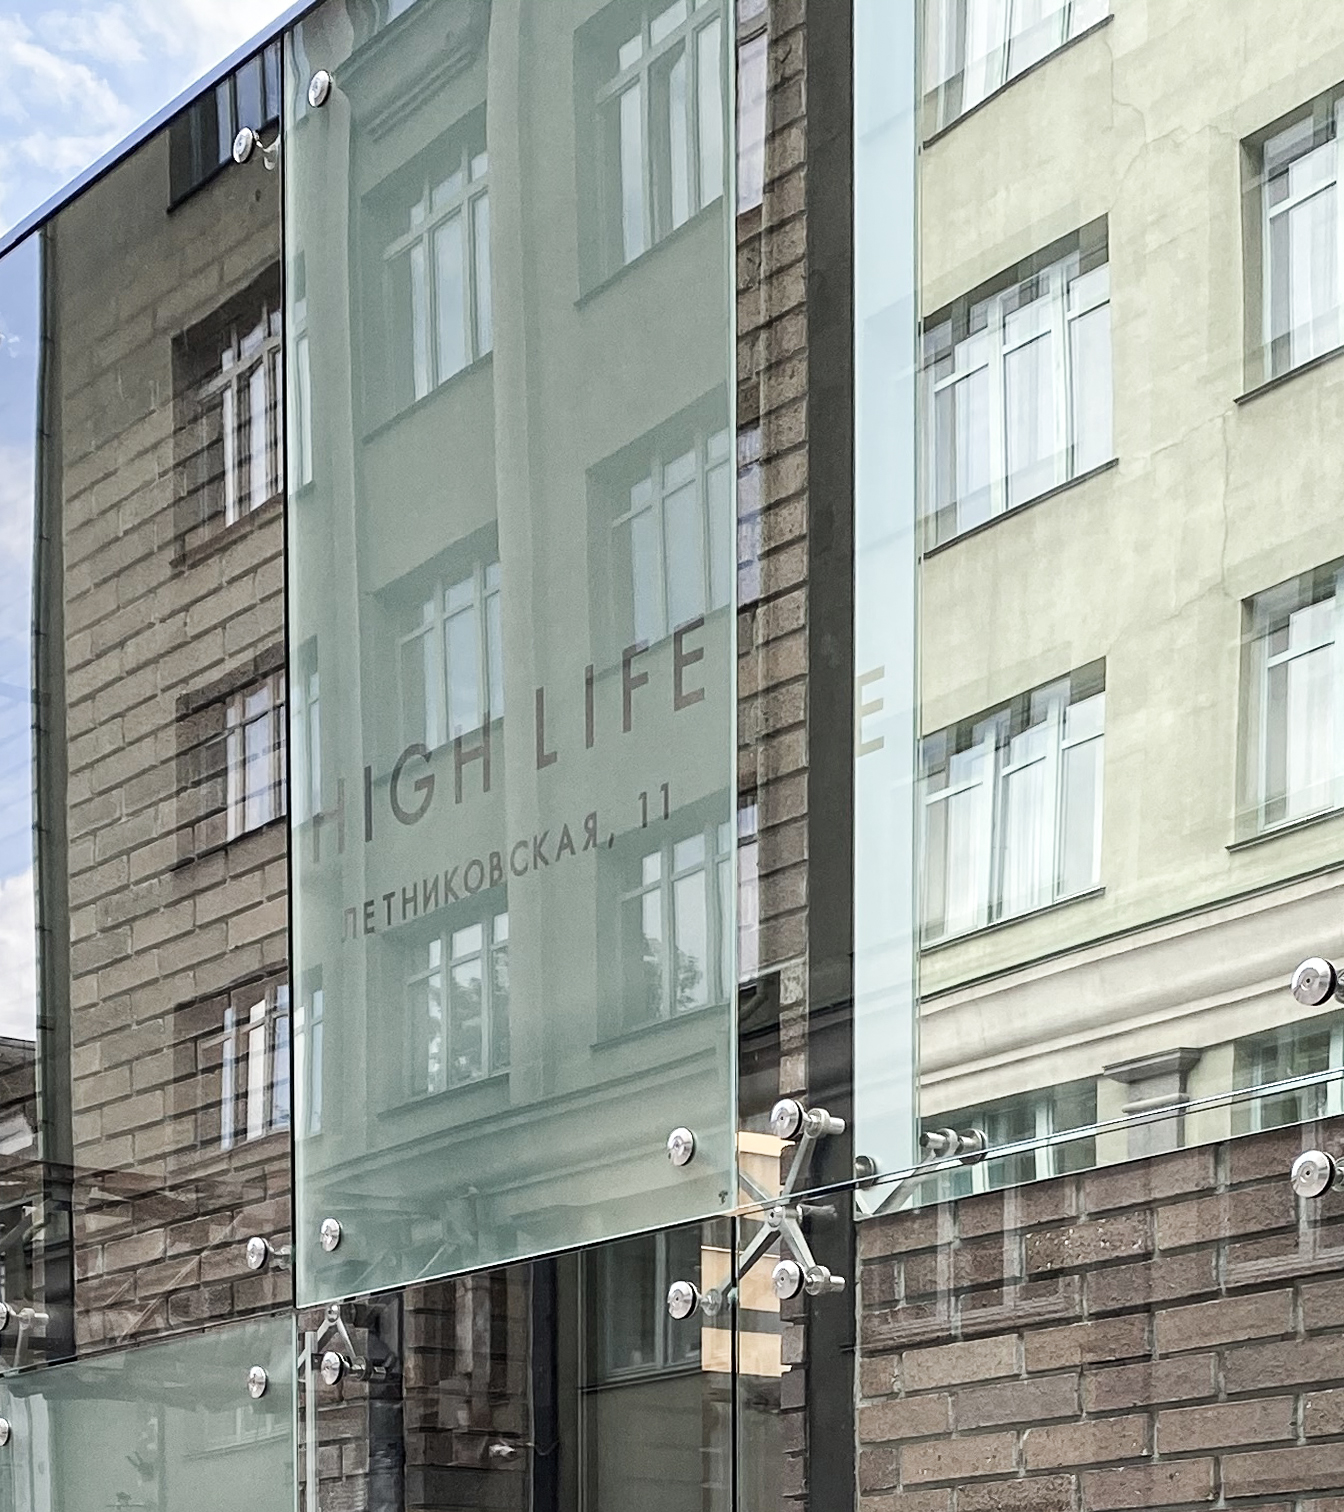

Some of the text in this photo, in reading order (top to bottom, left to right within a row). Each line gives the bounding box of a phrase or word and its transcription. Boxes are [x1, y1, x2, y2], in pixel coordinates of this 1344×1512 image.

[313, 617, 706, 863] HIGH LIFE
[342, 782, 671, 943] ЛЕТНИКОВСКАЯ, 11
